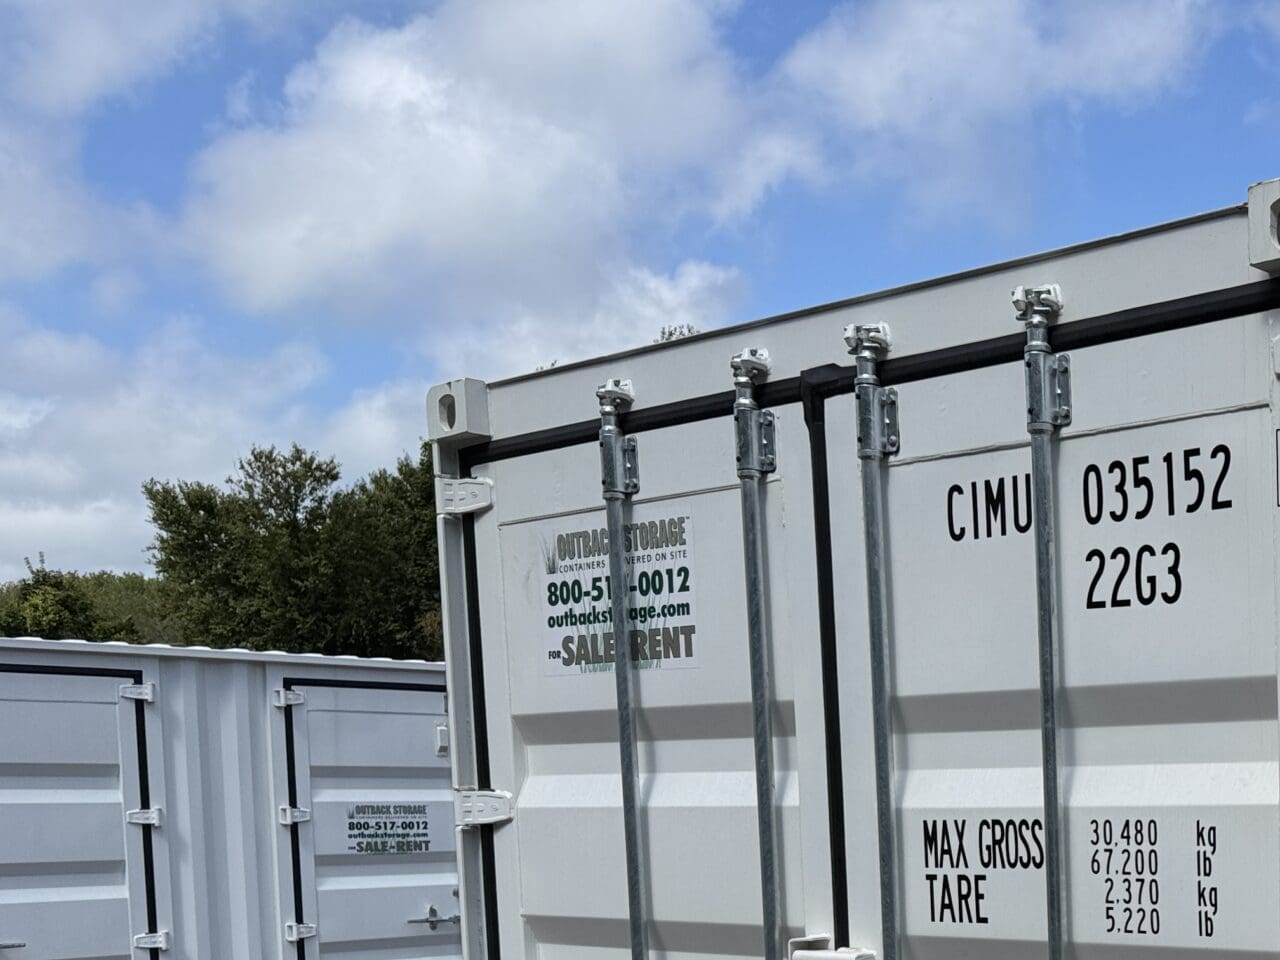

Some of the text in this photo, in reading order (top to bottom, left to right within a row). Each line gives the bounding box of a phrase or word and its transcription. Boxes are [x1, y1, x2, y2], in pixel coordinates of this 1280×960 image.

[947, 473, 1032, 542] CIMU
[1083, 444, 1232, 526] 035152
[557, 528, 610, 561] OUTBAC
[558, 560, 606, 574] CONTAINERS
[655, 552, 667, 562] ON
[670, 549, 688, 560] SITE
[1085, 542, 1182, 609] 22G3
[547, 566, 690, 606] 800-51-0012
[547, 602, 690, 629] outbackstage.com
[548, 625, 696, 667] FOR SALE RENT
[348, 820, 428, 831] 800-517-0012
[356, 840, 388, 852] SALE
[396, 840, 430, 852] RENT
[923, 818, 1216, 869] MAX GROSS 30,480 kg
[1091, 849, 1212, 877] 67,200 lb
[925, 874, 1218, 924] TARE 2,370 kg
[1106, 907, 1214, 937] 5,220 lb
